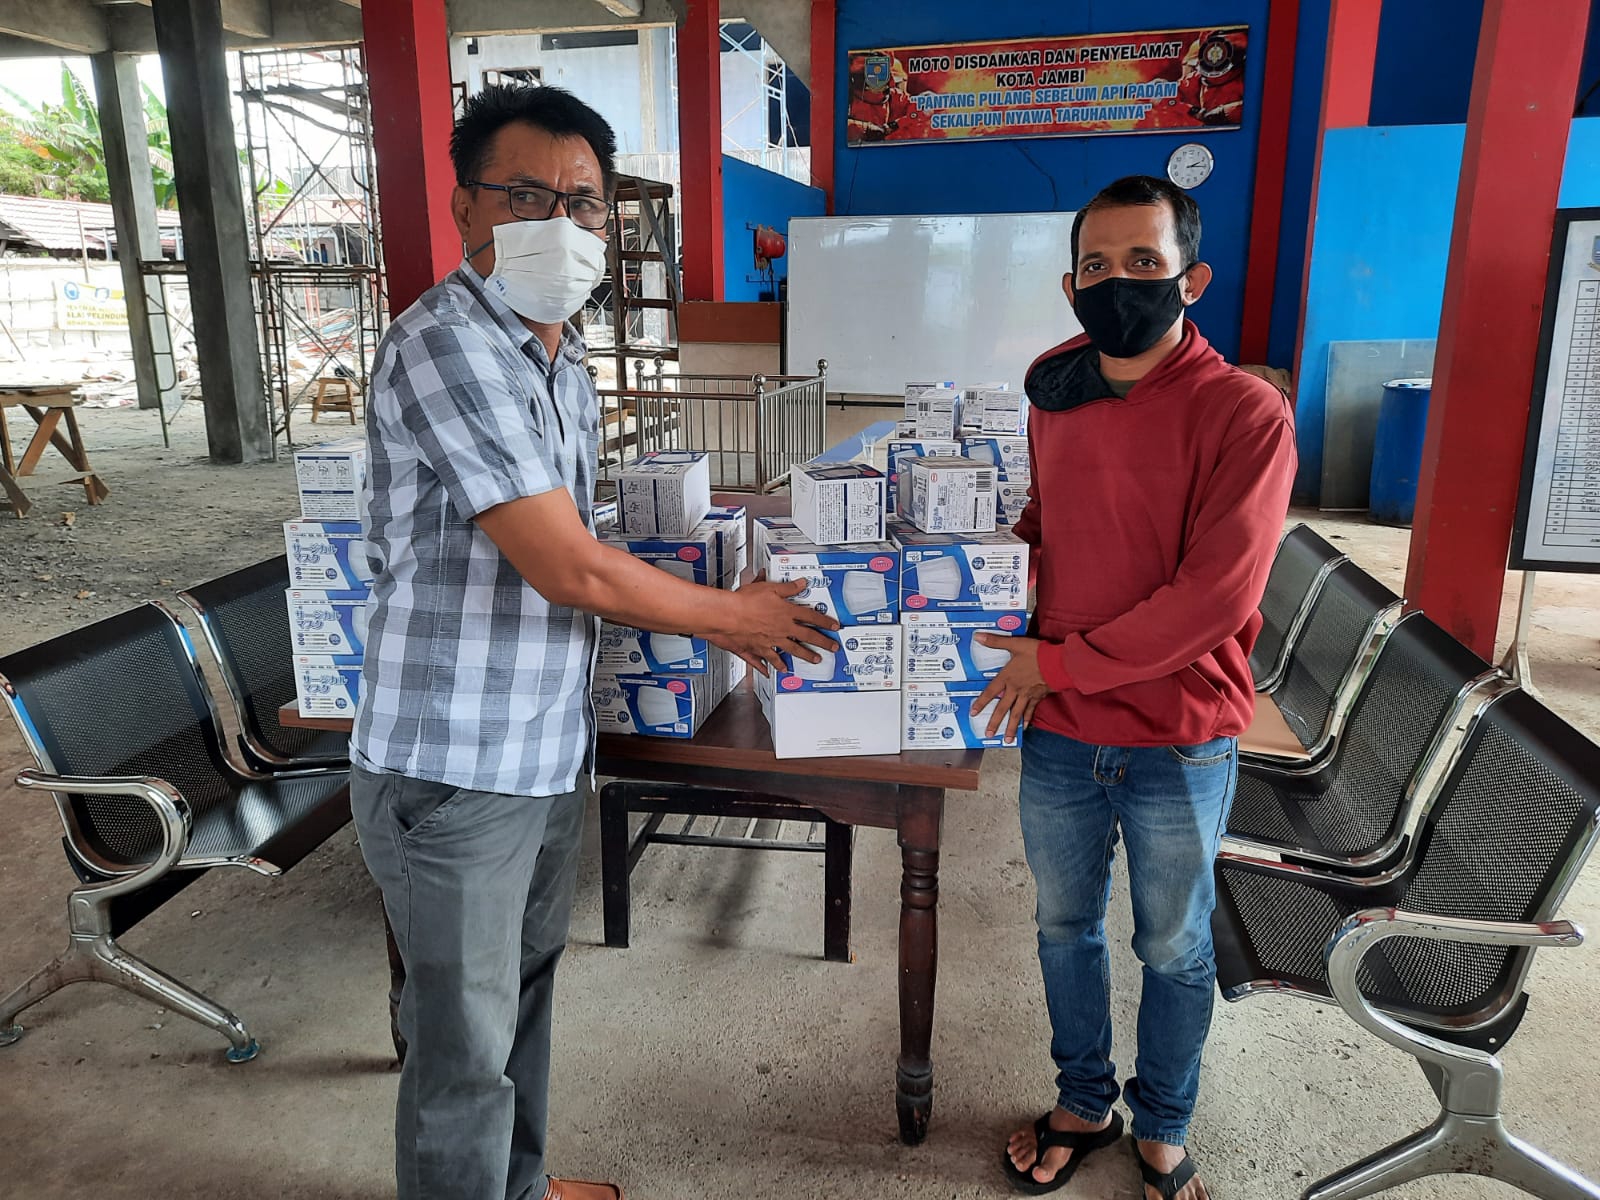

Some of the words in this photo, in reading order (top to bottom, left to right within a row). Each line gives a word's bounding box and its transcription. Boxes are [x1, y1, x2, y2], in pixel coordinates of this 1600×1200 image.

[909, 57, 950, 73] MOTO
[954, 51, 1040, 70] DISDAMKAR
[1044, 48, 1075, 64] DAN
[1080, 42, 1182, 63] PENYELAMAT
[996, 71, 1035, 88] KOTA
[1038, 68, 1085, 85] JAMBI
[979, 90, 1032, 107] PULANG
[1035, 85, 1097, 103] SEBELUM
[1100, 84, 1125, 100] API
[1127, 81, 1179, 99] PADAM
[930, 111, 1001, 129] SEKALIPUN
[1005, 108, 1053, 125] NYAWA
[969, 583, 1021, 594] サージカル
[601, 627, 642, 639] ージカル
[909, 634, 960, 645] サージカル
[909, 644, 940, 655] マスク
[843, 664, 894, 676] サージカル
[592, 687, 630, 699] ージカル
[909, 703, 960, 713] サージカル
[909, 713, 939, 723] マスク
